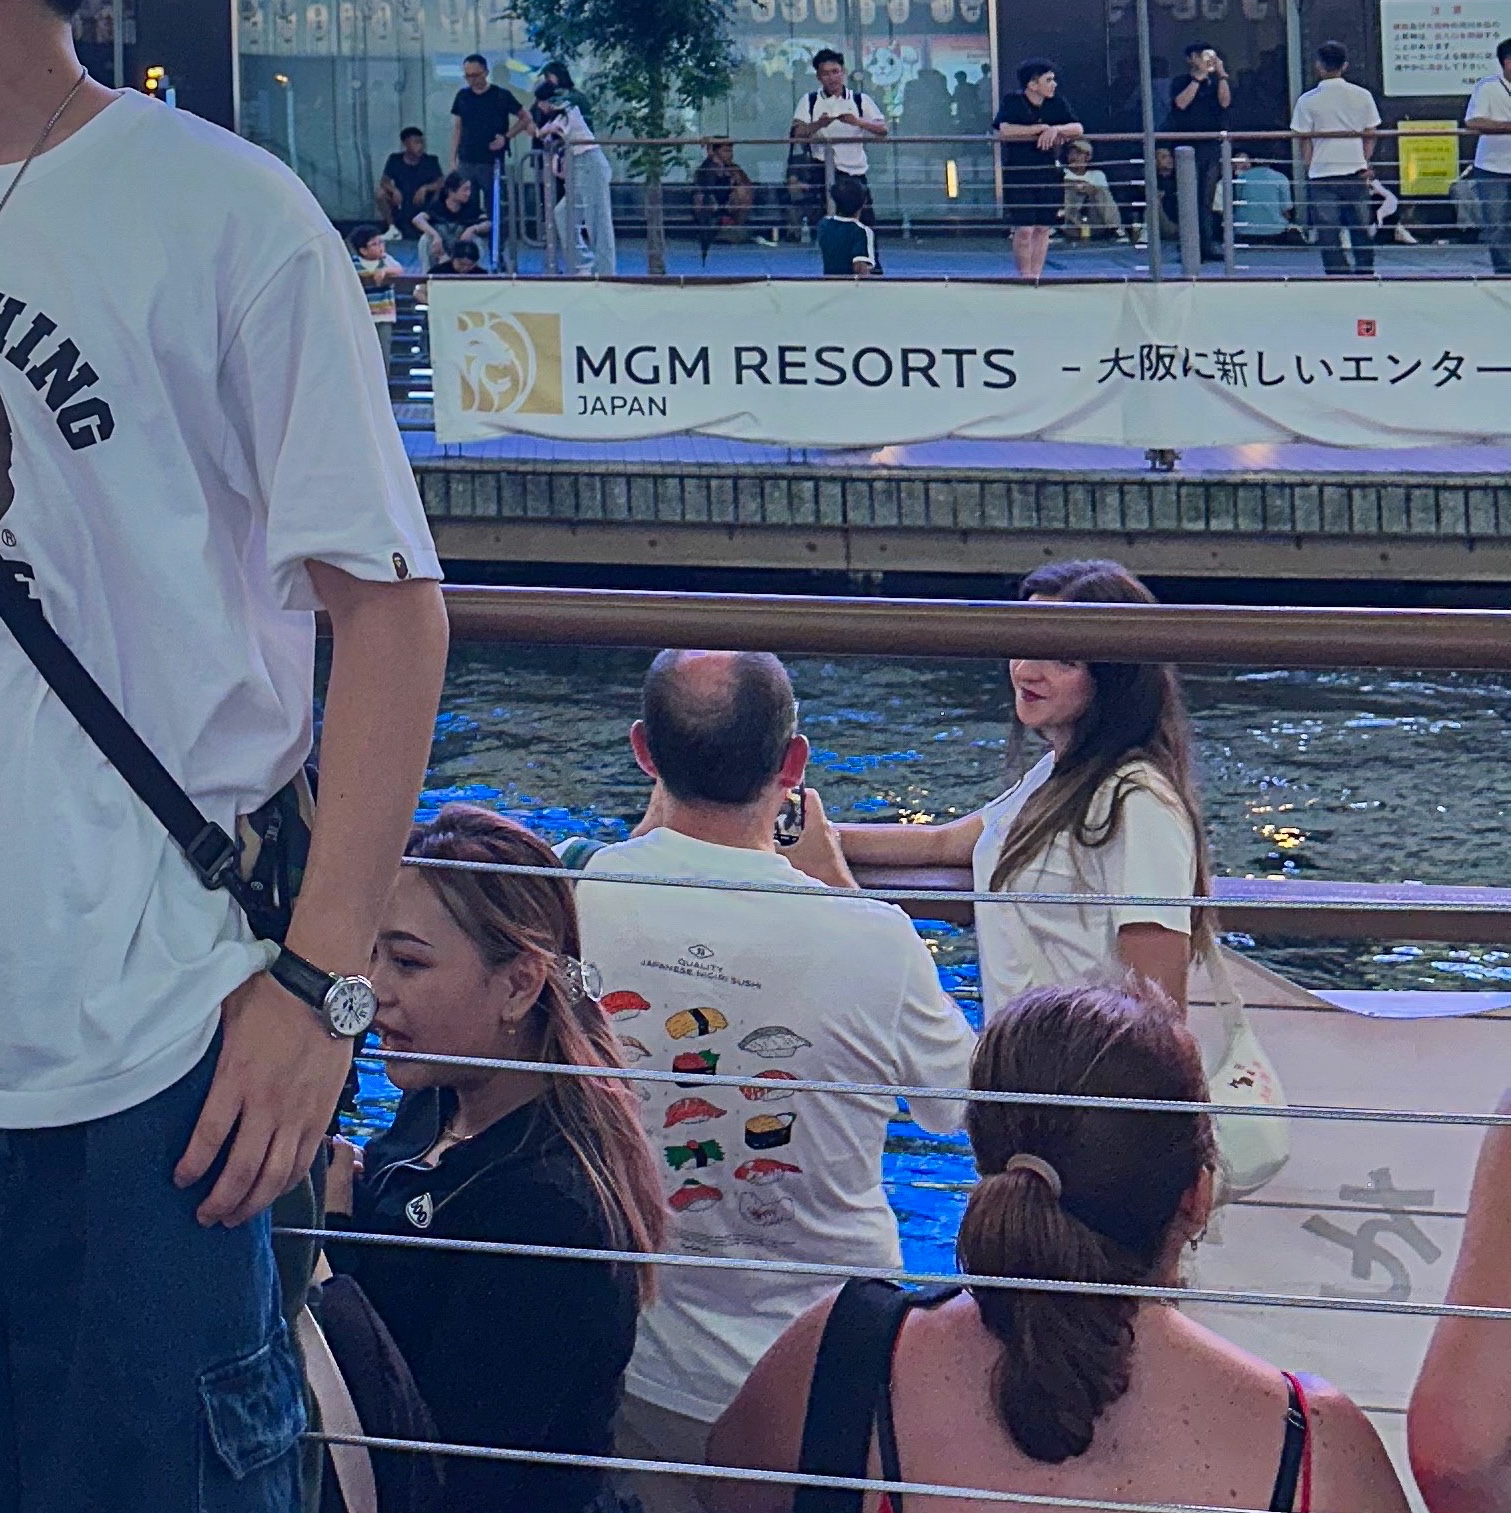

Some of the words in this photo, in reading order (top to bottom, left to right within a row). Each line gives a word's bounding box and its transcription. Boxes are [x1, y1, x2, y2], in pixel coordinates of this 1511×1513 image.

[575, 344, 712, 387] MGM
[734, 345, 1018, 391] RESORTS
[576, 394, 669, 418] JAPAN
